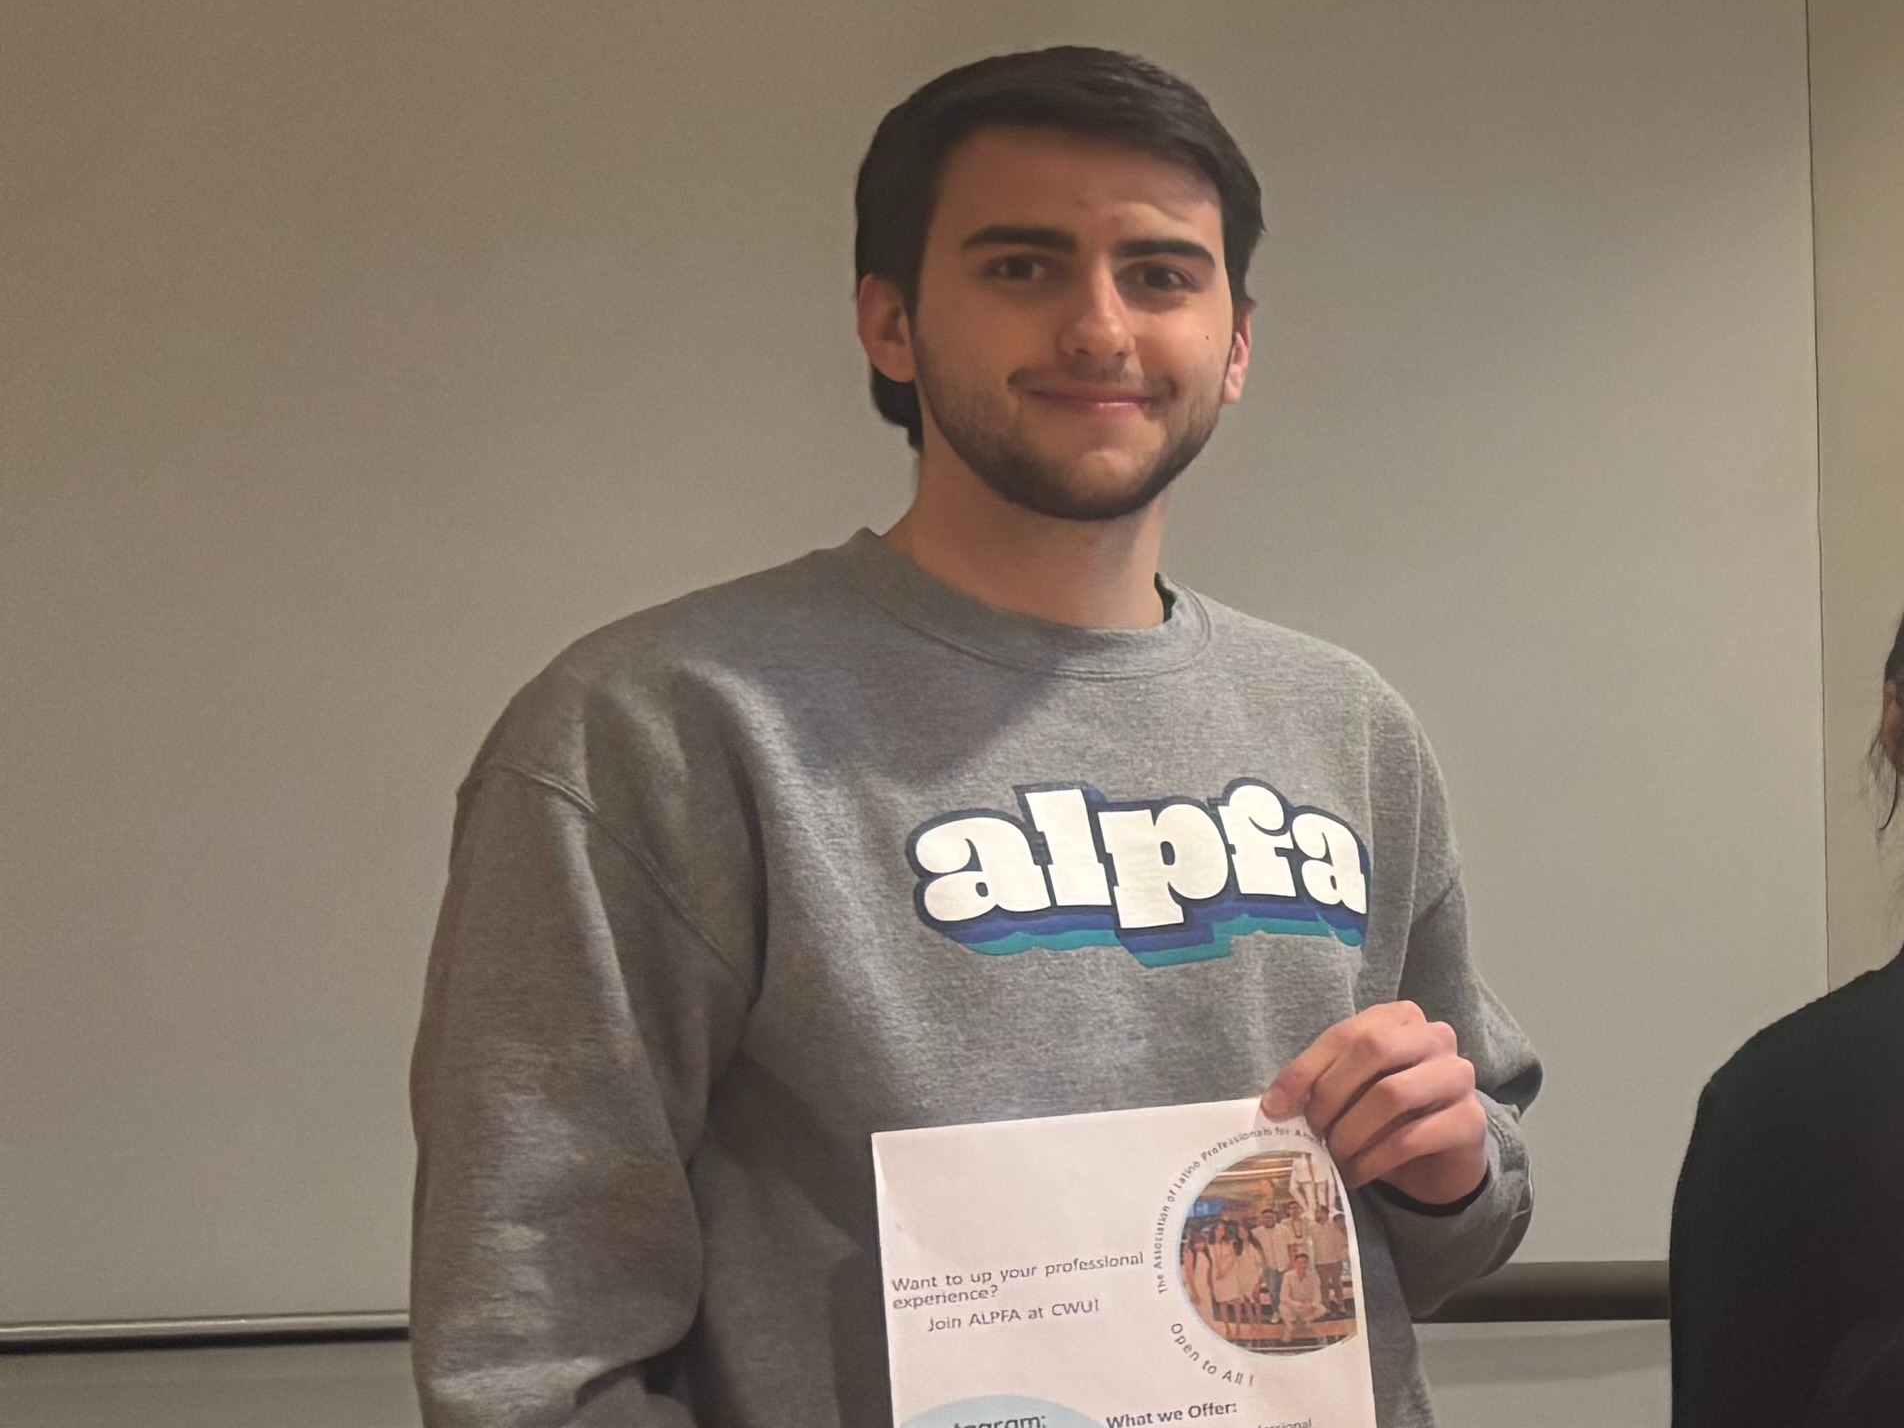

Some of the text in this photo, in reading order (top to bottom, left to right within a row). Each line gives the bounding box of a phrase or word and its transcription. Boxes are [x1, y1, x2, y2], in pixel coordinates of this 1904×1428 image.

[912, 781, 1368, 932] alpfa
[892, 1252, 1144, 1292] Want to up your professional
[893, 1285, 998, 1310] experience?
[928, 1316, 962, 1332] Join
[969, 1309, 1020, 1327] ALPFA
[1028, 1307, 1044, 1320] at
[1171, 1323, 1200, 1361] Open
[1202, 1360, 1217, 1375] to
[1222, 1370, 1244, 1385] All
[1157, 1410, 1183, 1422] we
[1188, 1402, 1237, 1418] Offer:
